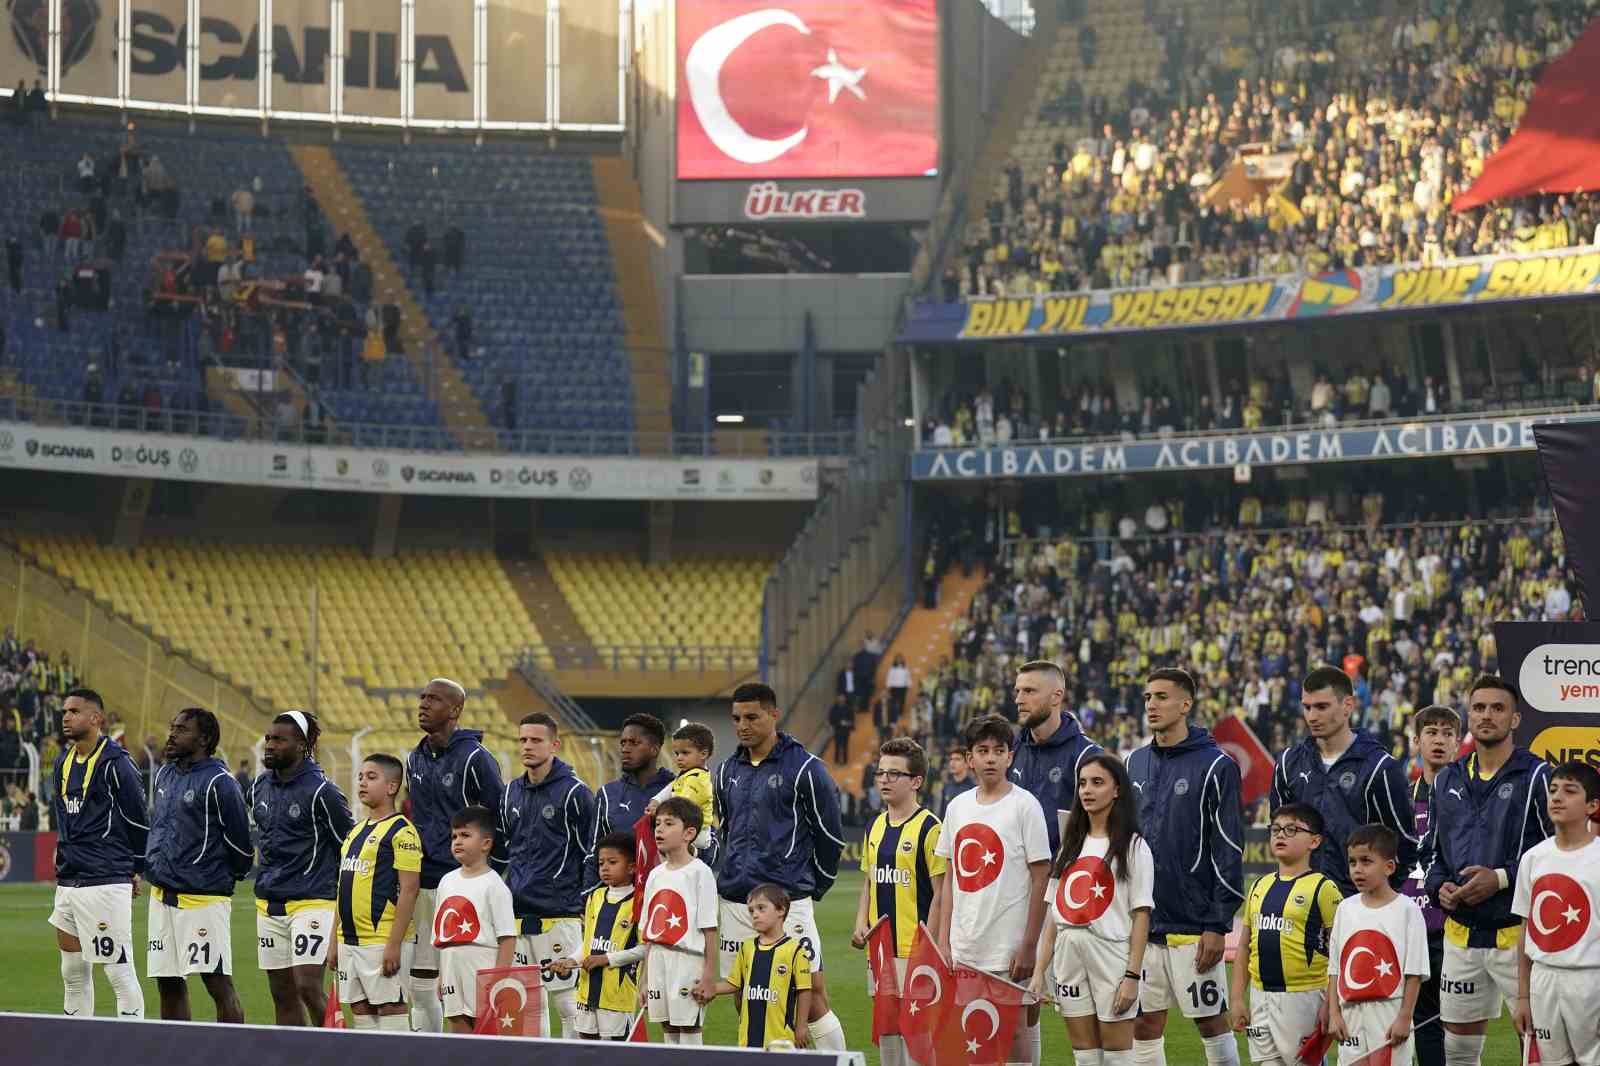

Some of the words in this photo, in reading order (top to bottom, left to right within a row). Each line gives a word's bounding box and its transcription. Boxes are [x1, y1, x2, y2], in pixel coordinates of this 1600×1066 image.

[114, 10, 469, 93] SCANIA
[746, 182, 864, 218] ÜLKER
[41, 443, 95, 460] SCANIA
[929, 446, 1127, 478] ACIBADEM
[1155, 433, 1343, 468] ACIBADEM
[1371, 418, 1567, 456] ACIBADE
[417, 469, 477, 484] SCANIA
[92, 935, 114, 957] 19
[188, 942, 210, 965] 21
[294, 933, 324, 957] 97
[1187, 980, 1219, 1008] 16
